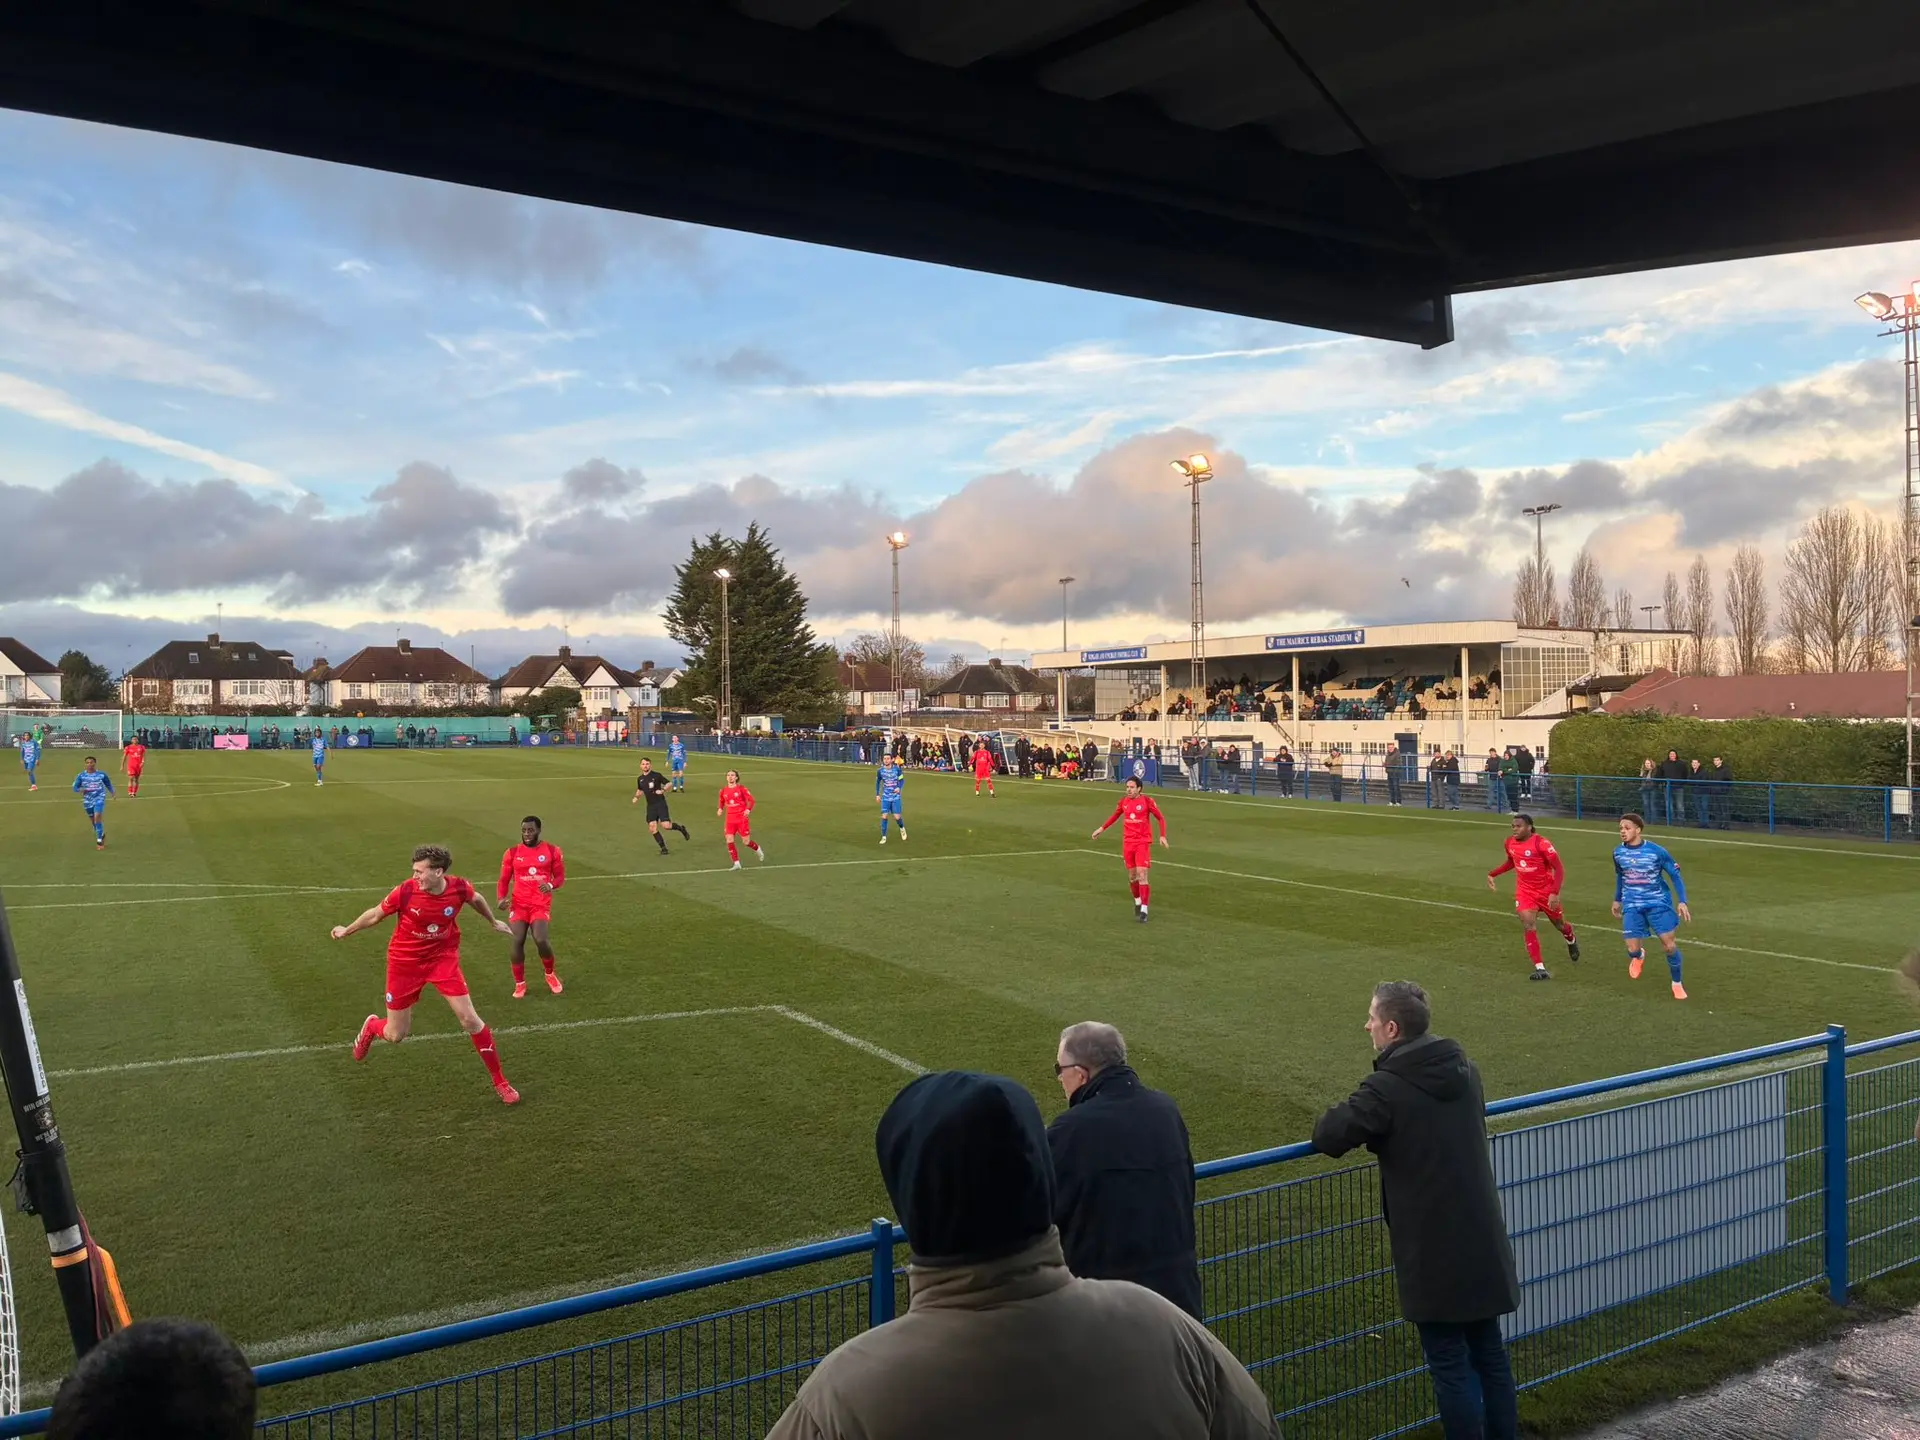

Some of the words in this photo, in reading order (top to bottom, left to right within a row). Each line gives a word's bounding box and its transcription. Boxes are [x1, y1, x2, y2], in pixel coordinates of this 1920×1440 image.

[1276, 638, 1286, 646] THE
[1286, 636, 1310, 645] MAURICE
[1328, 633, 1352, 643] STADIUM
